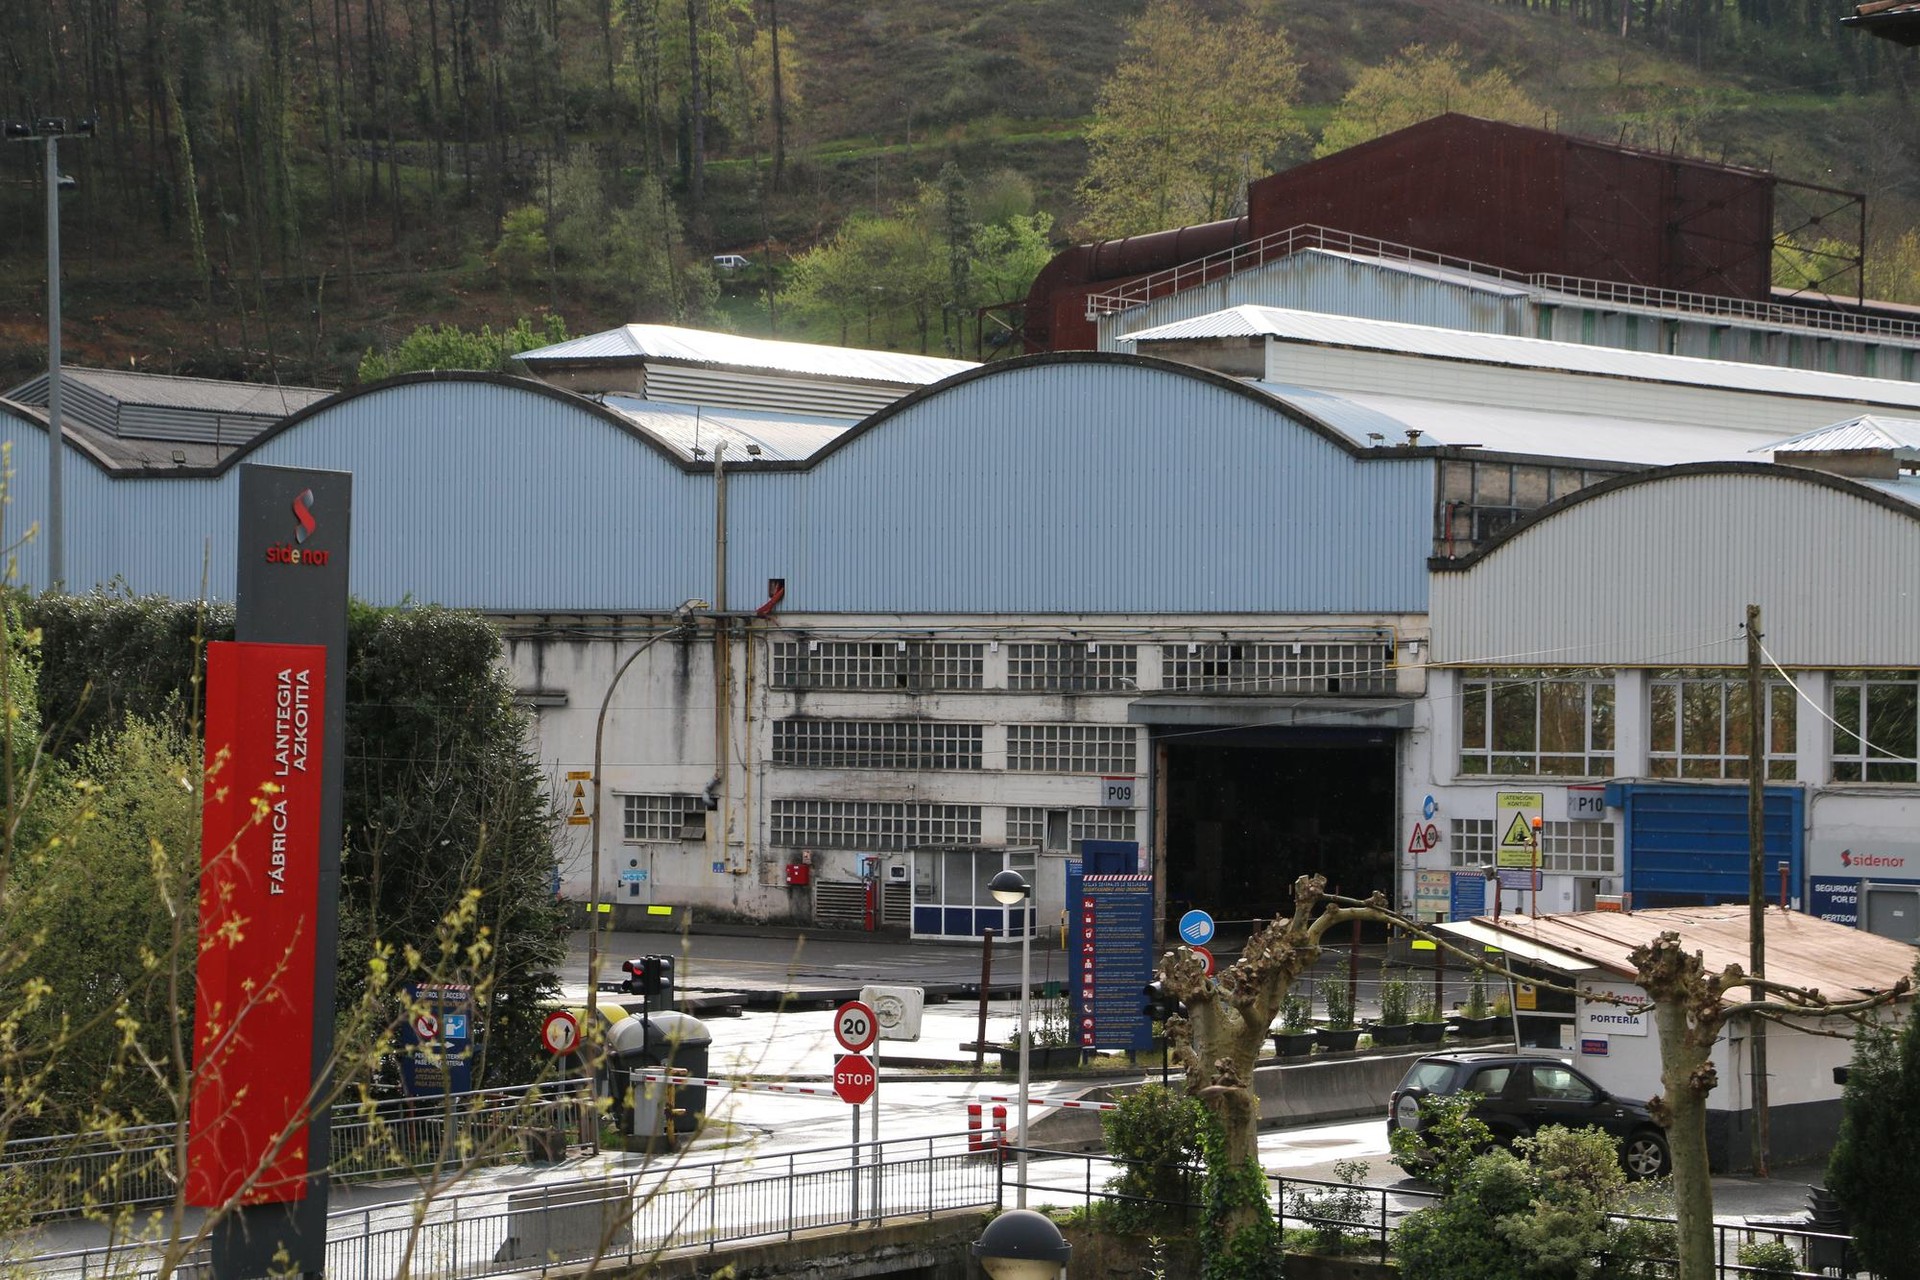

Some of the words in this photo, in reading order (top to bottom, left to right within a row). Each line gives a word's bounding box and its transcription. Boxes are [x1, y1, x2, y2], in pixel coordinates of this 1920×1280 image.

[266, 543, 329, 566] sidenor
[275, 668, 292, 776] LANTEGIA
[293, 669, 310, 771] AZKOITIA
[1108, 786, 1131, 800] P09
[1579, 797, 1603, 812] P10
[268, 800, 288, 895] FÁBRICA
[1853, 854, 1905, 867] sidenor
[843, 1018, 866, 1035] 20
[837, 1073, 872, 1085] STOP
